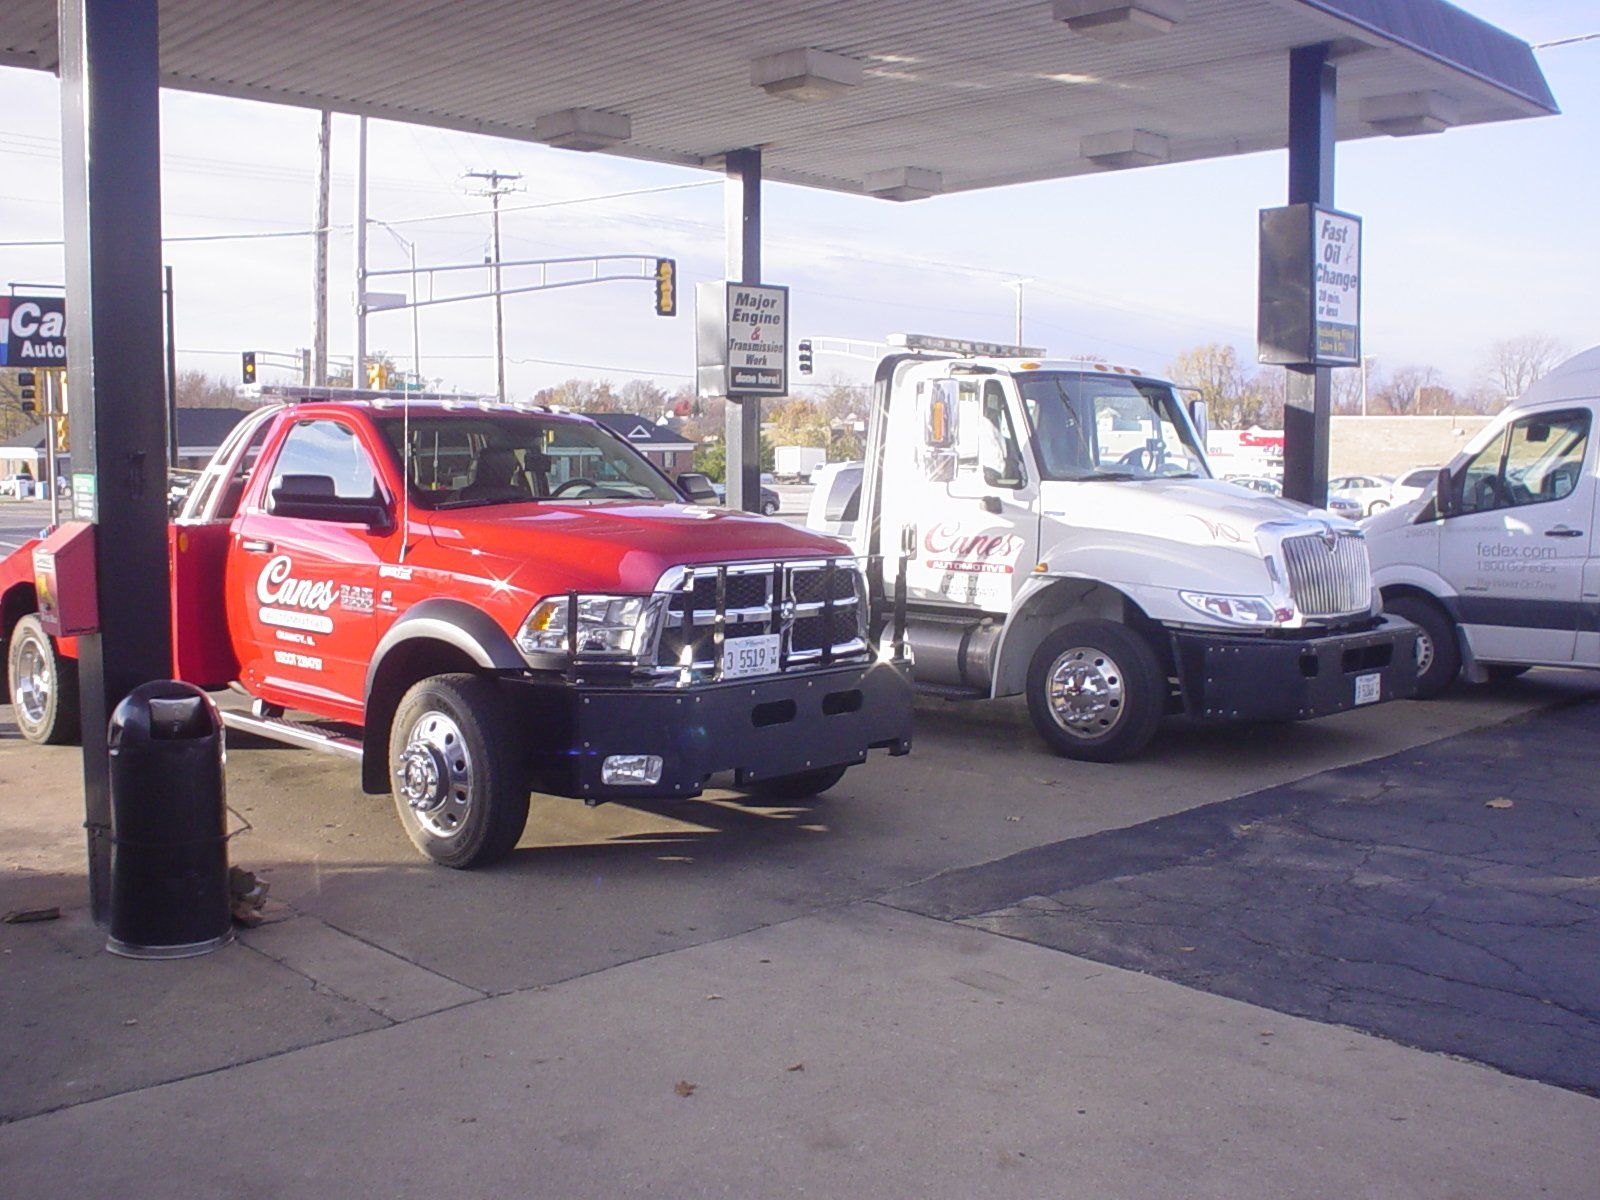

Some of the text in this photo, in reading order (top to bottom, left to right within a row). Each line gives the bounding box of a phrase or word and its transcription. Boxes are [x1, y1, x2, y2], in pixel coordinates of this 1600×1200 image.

[1321, 219, 1348, 244] Fast
[1324, 243, 1341, 264] Oil
[1316, 262, 1357, 292] Change
[735, 292, 777, 310] Major
[11, 302, 66, 338] Ca
[732, 308, 780, 326] Engine
[751, 326, 761, 340] &
[729, 338, 783, 353] Transmission
[746, 354, 768, 366] Work
[924, 521, 1023, 557] Canes
[1476, 542, 1557, 559] fedex.com
[257, 555, 339, 610] Canes
[727, 648, 765, 670] 3 5519
